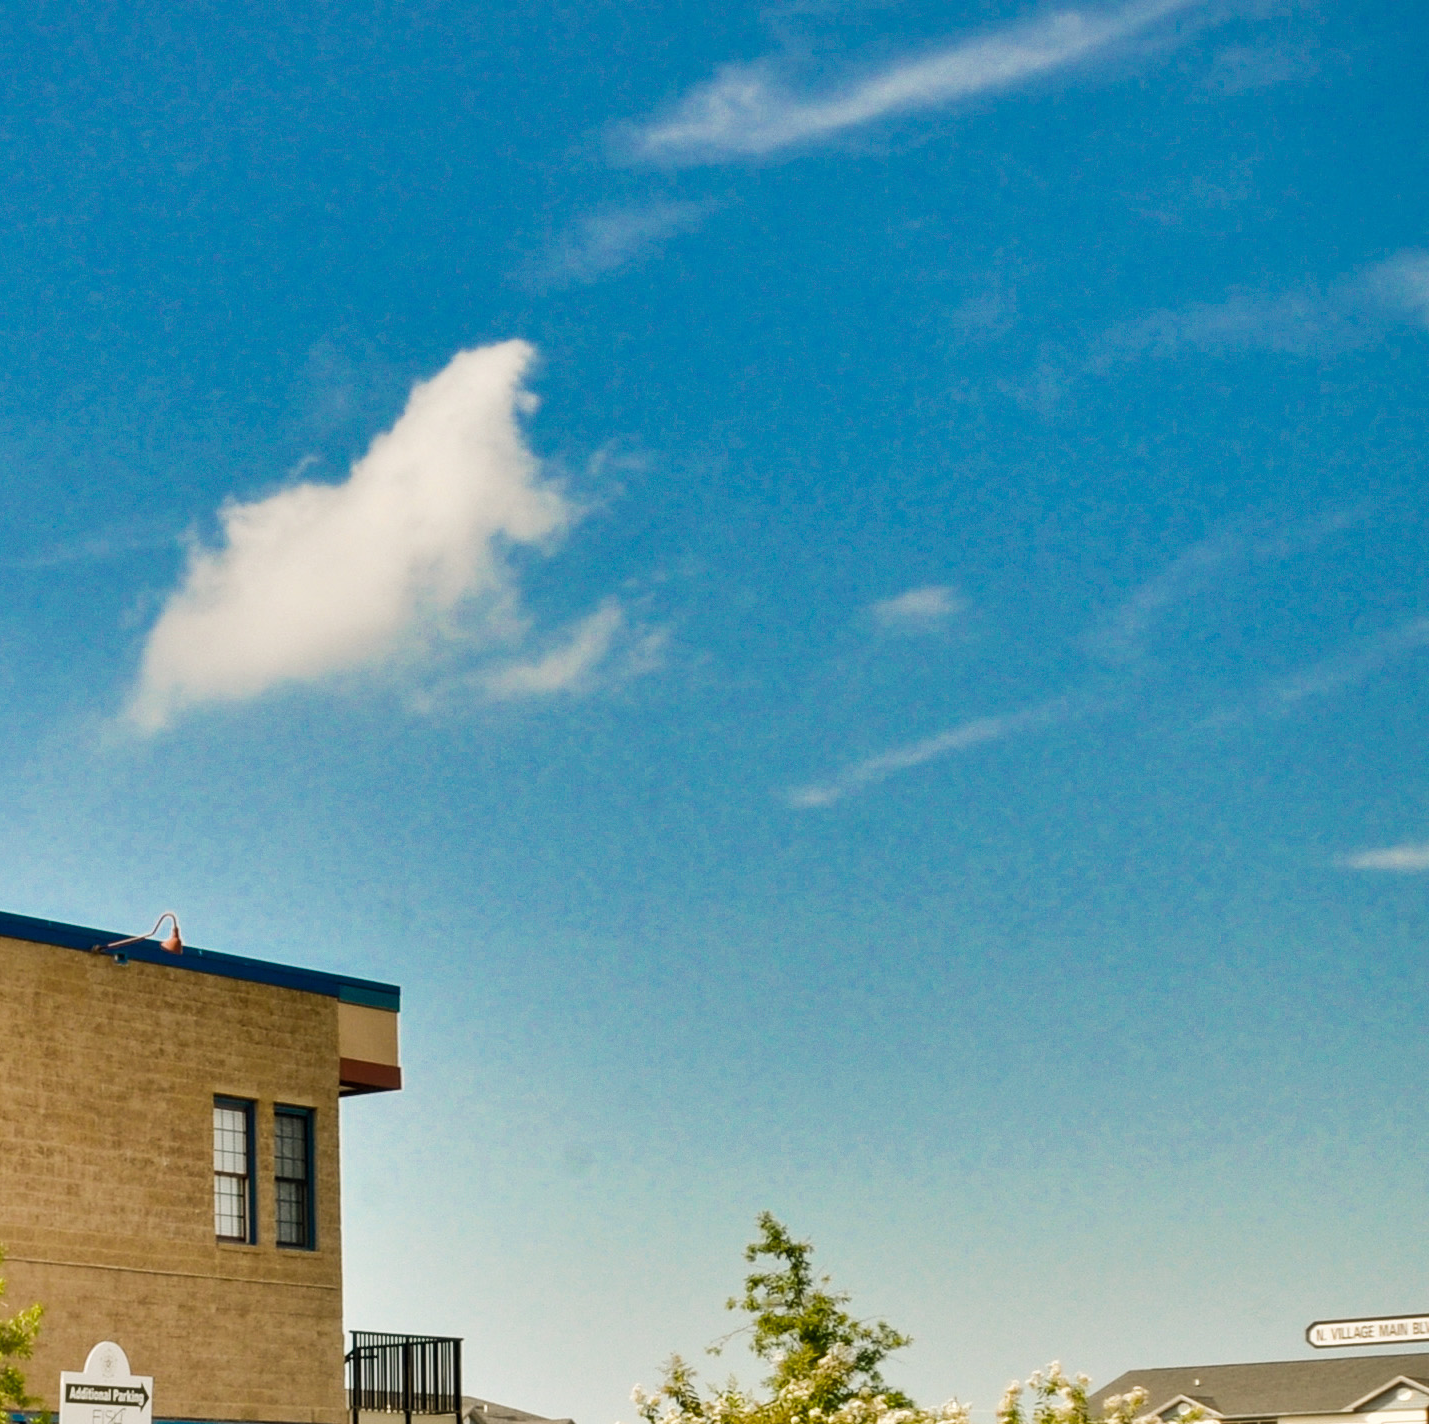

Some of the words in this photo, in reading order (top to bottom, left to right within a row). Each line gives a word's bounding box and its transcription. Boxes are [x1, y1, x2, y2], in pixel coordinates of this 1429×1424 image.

[1331, 1325, 1374, 1340] VILLAGE
[1379, 1323, 1408, 1337] MAIN
[69, 1386, 111, 1402] Additional
[113, 1389, 145, 1406] Parking
